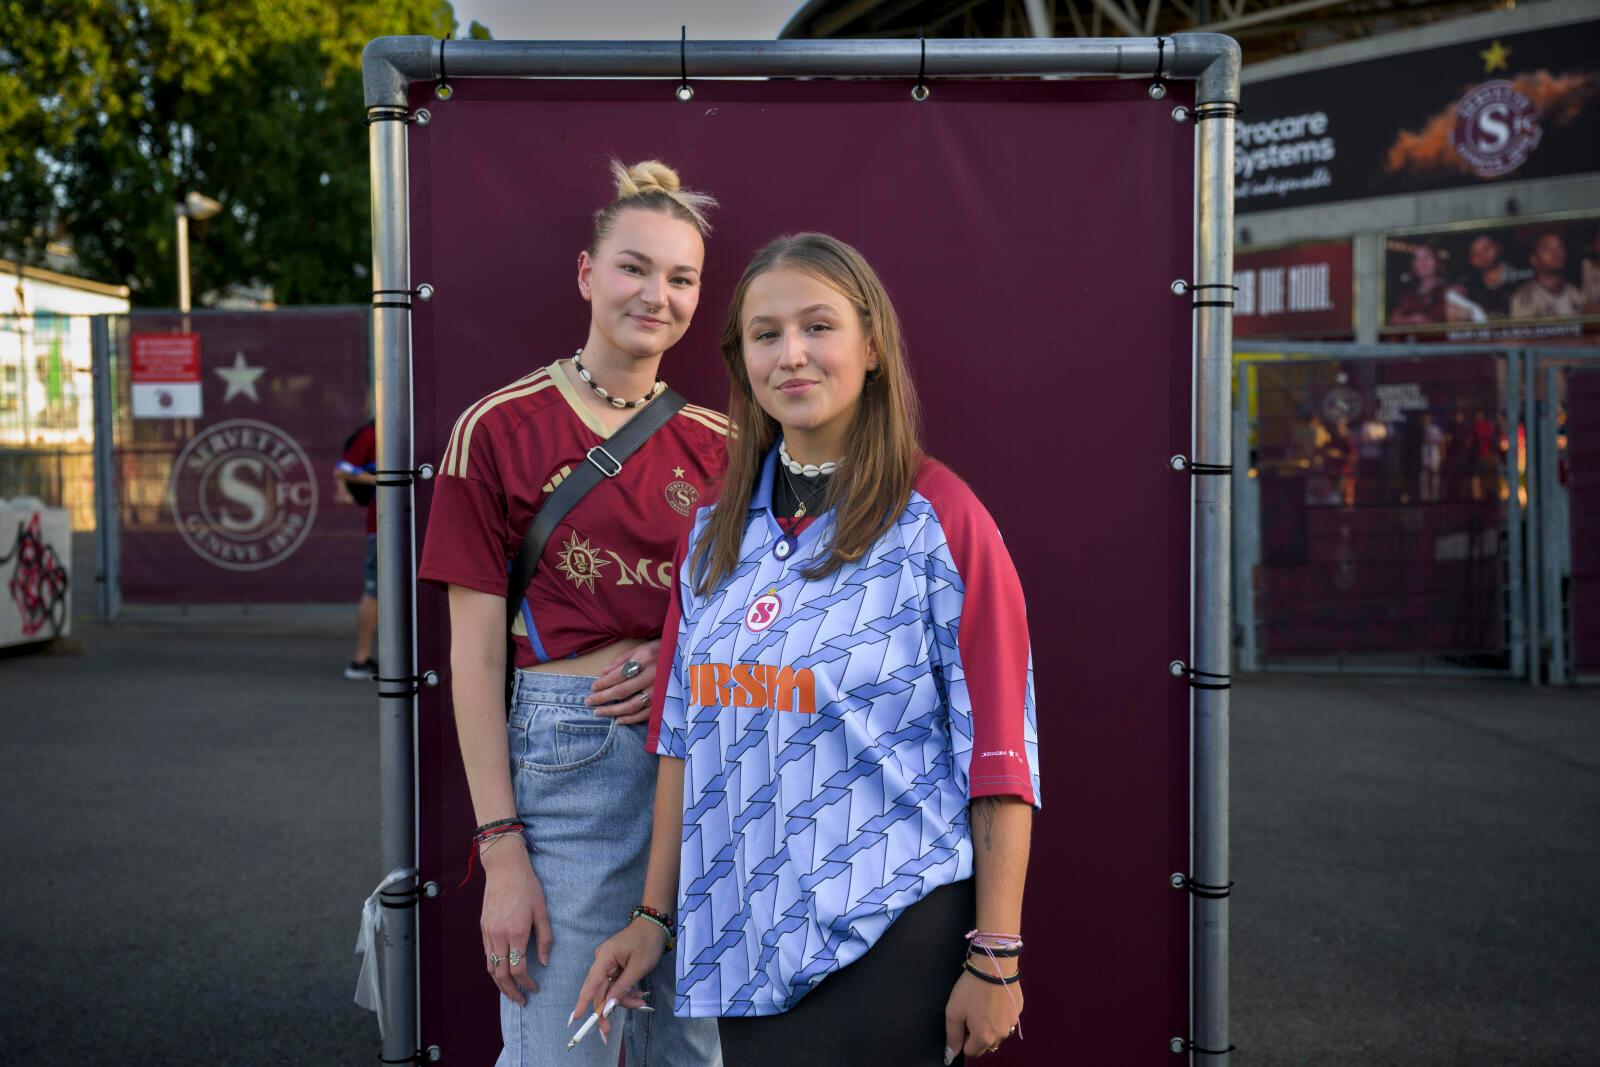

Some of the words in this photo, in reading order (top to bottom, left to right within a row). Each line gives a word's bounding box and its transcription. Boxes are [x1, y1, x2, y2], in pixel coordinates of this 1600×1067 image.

[1478, 102, 1510, 152] S
[188, 429, 297, 470] SERVETTE
[217, 457, 268, 531] S
[276, 482, 310, 506] FC
[676, 489, 691, 507] S
[750, 602, 776, 624] S
